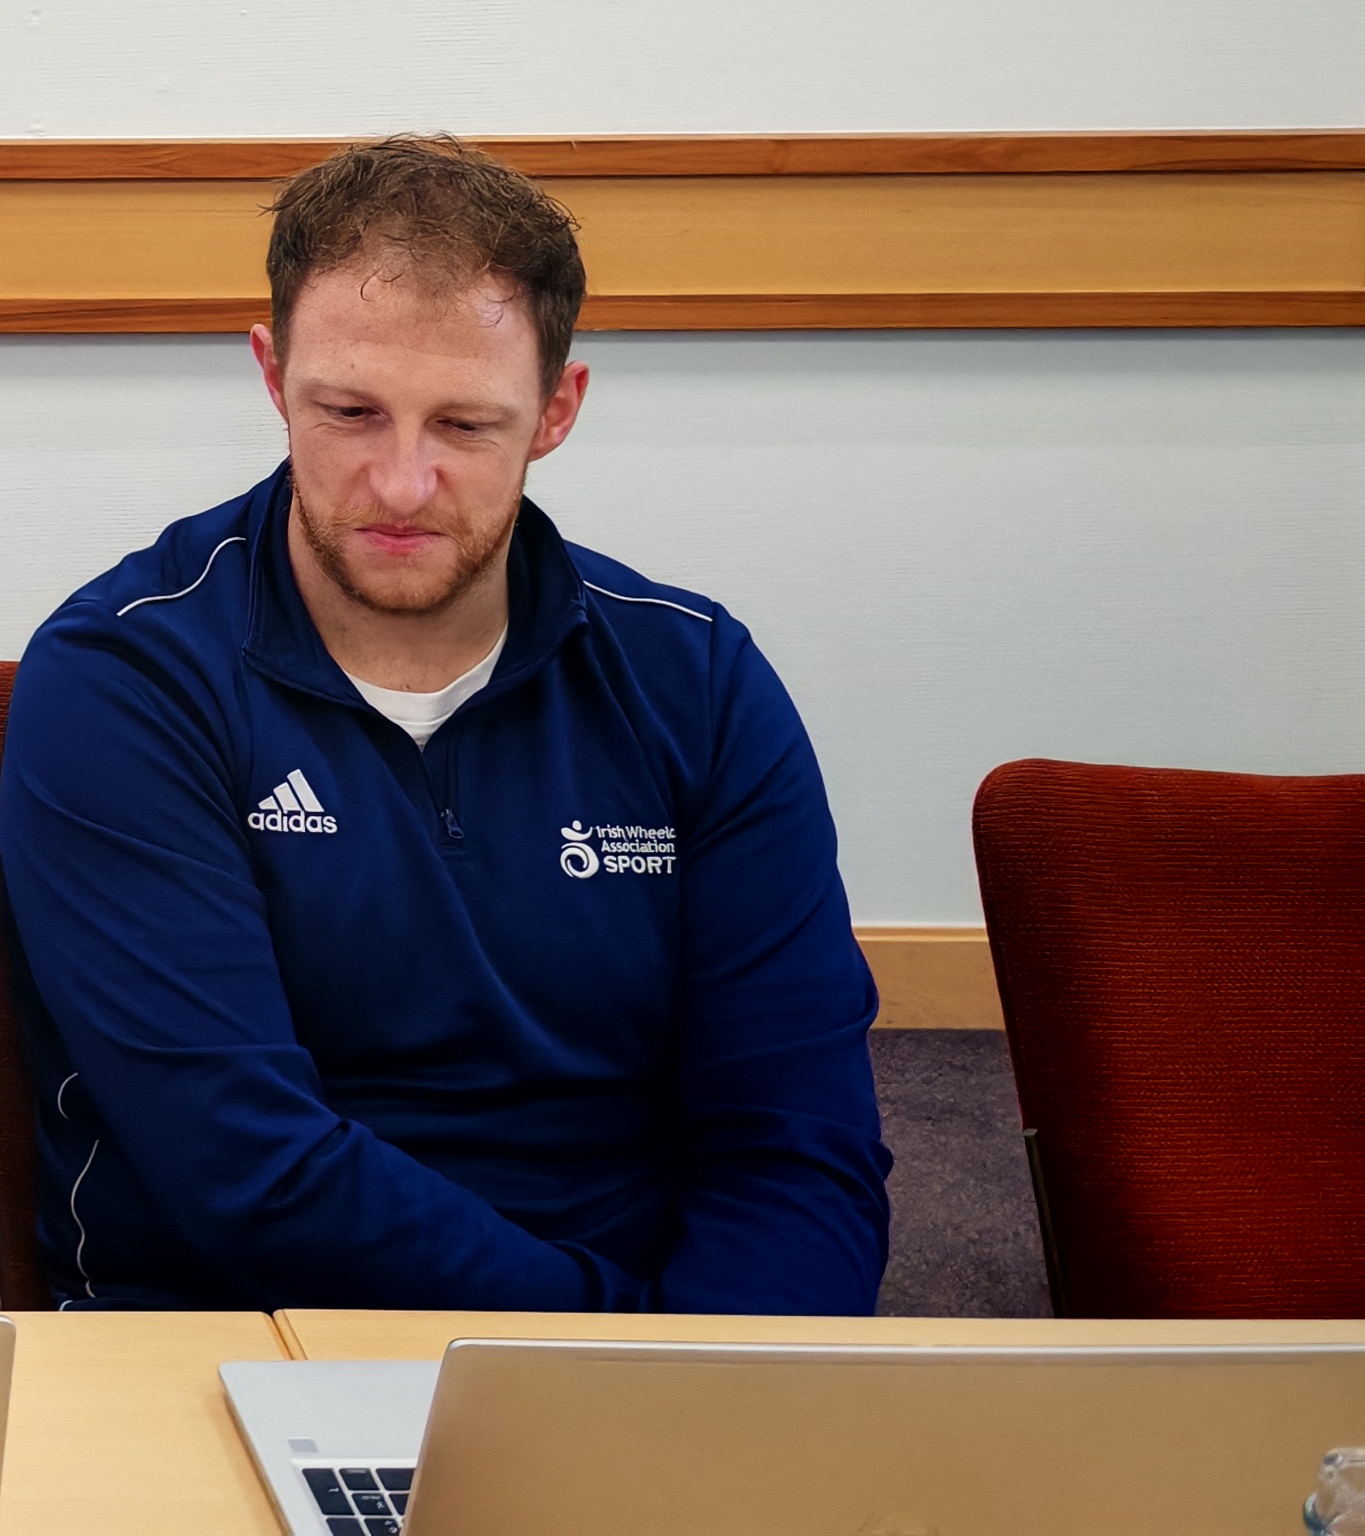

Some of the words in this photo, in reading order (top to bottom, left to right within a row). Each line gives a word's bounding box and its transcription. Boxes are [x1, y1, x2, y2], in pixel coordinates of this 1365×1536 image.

[247, 809, 338, 834] adidas
[595, 824, 625, 839] Irish
[601, 839, 675, 853] Association
[603, 855, 677, 874] SPORT
